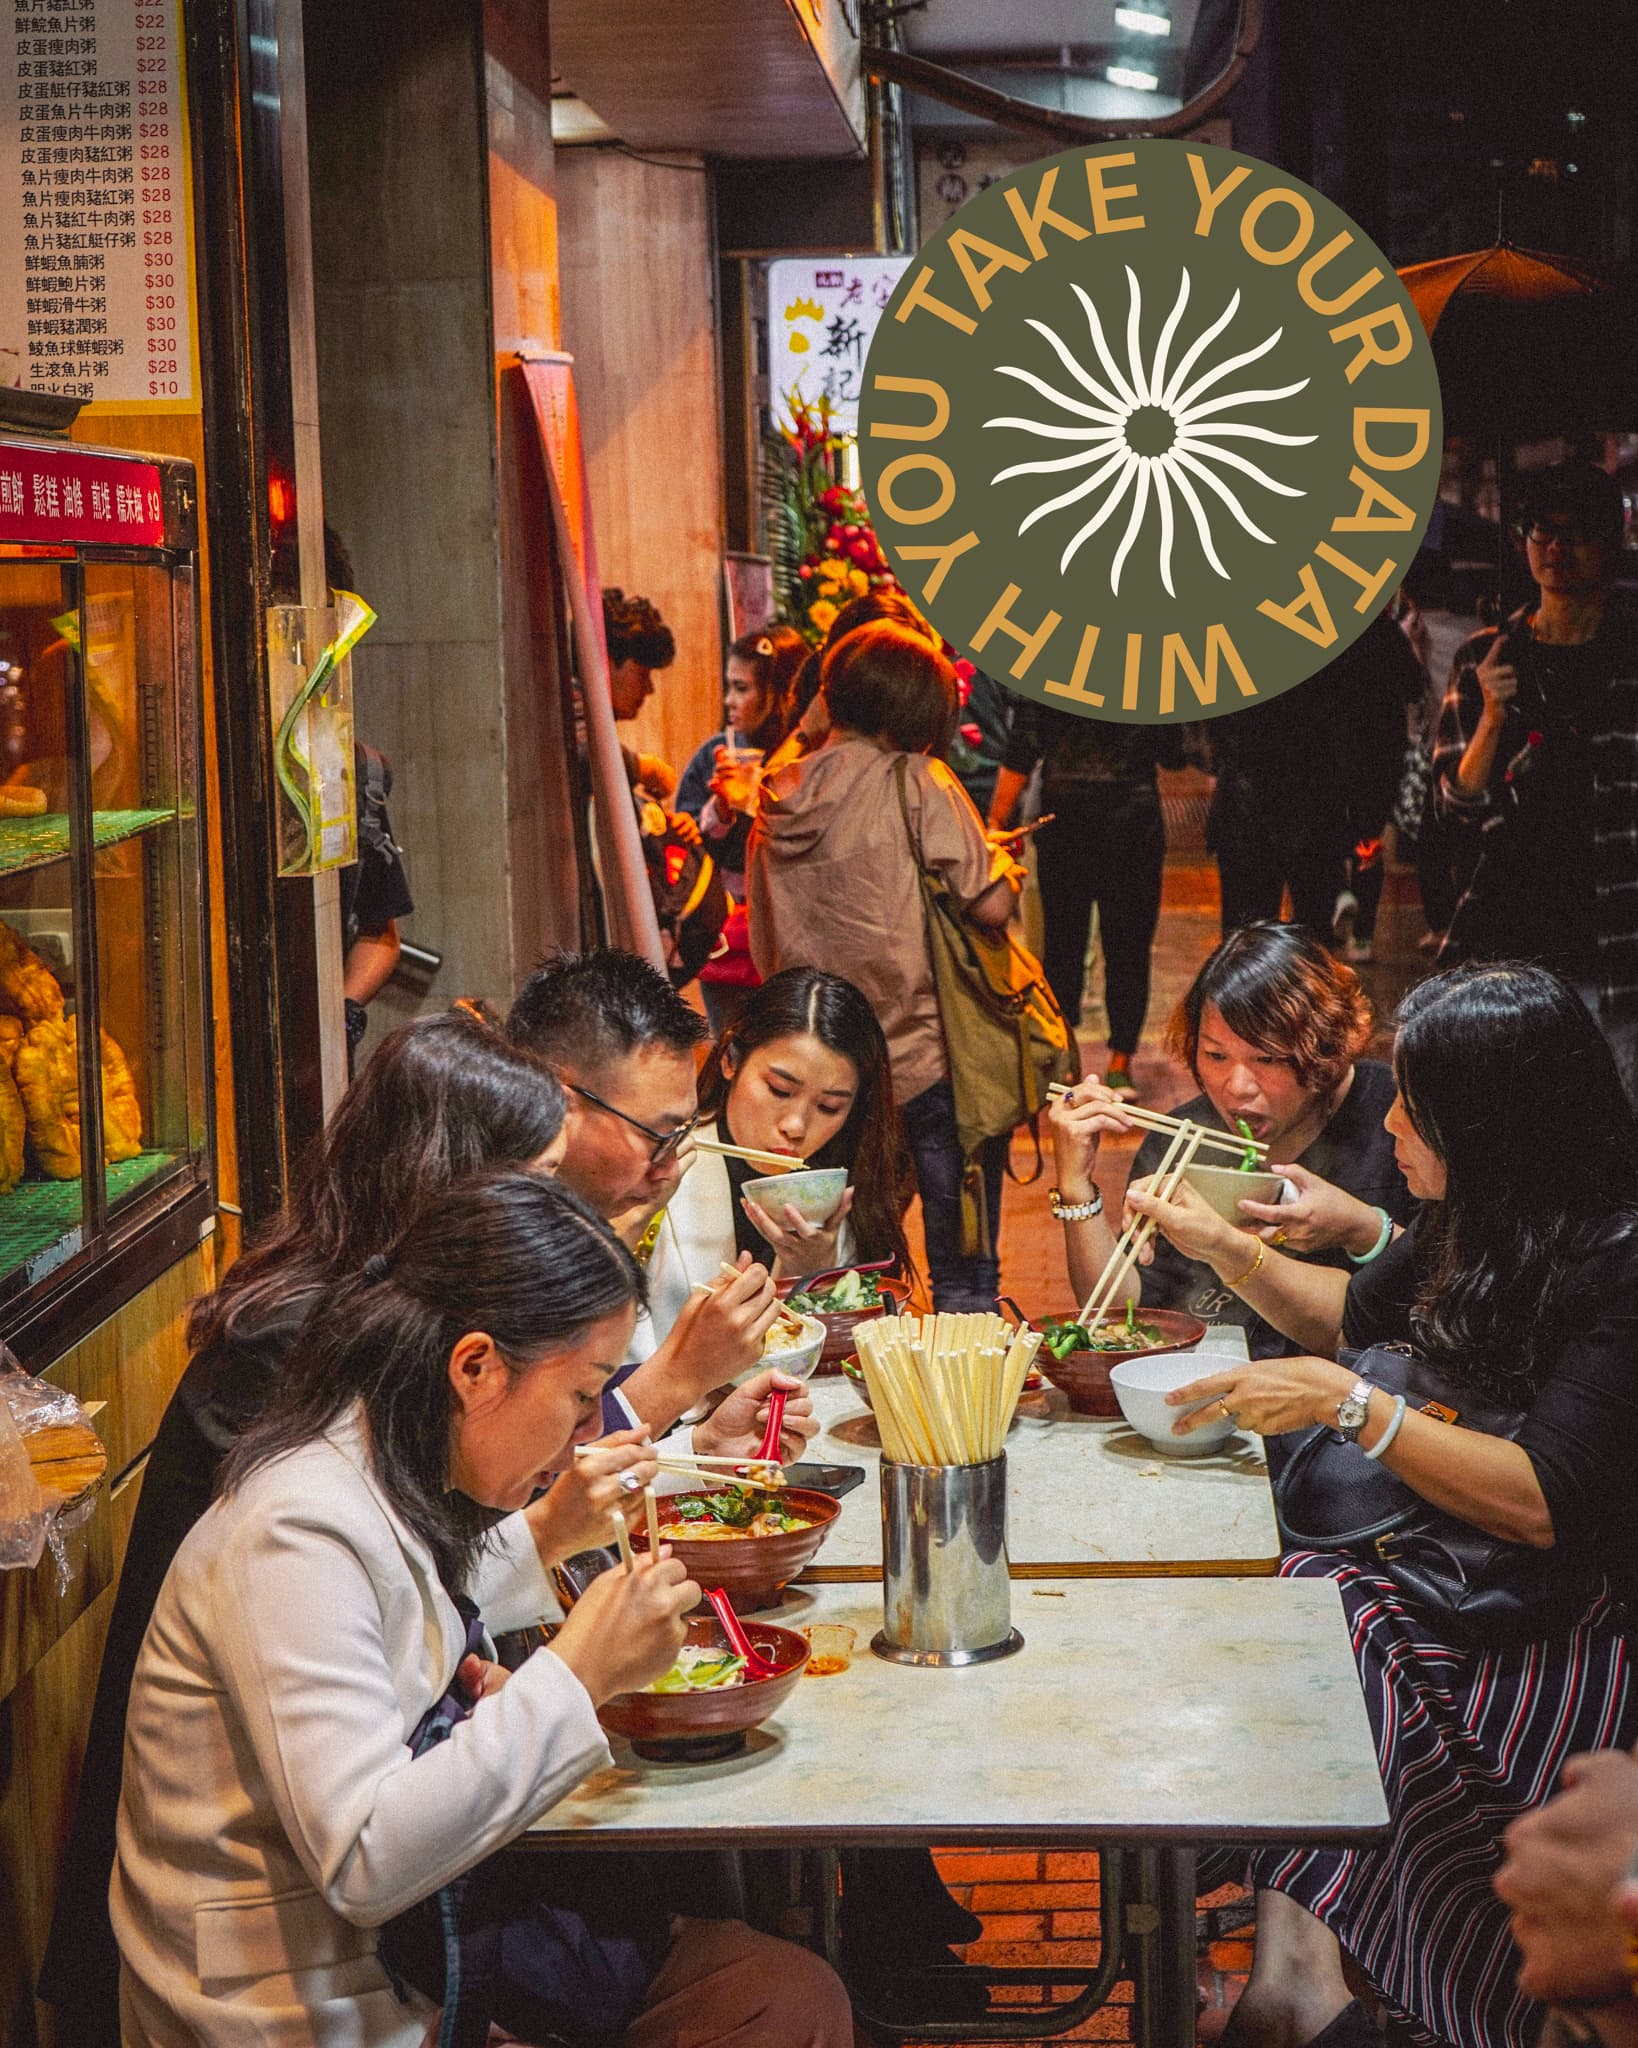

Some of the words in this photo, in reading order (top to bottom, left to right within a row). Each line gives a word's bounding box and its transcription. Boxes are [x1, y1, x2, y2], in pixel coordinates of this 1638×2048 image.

[136, 15, 165, 29] $22
[137, 36, 167, 51] $22
[137, 58, 167, 72] $22
[138, 80, 168, 94] $28
[139, 102, 168, 117] $28
[140, 123, 169, 138] $28
[141, 145, 170, 159] $28
[142, 167, 171, 181] $28
[142, 189, 172, 202] $28
[143, 210, 172, 224] $28
[144, 232, 173, 245] $28
[145, 253, 174, 267] $30
[145, 274, 175, 288] $30
[146, 296, 175, 310] $30
[147, 317, 176, 331] $30
[148, 338, 177, 352] $30
[149, 360, 178, 374] $28
[149, 381, 178, 395] $10
